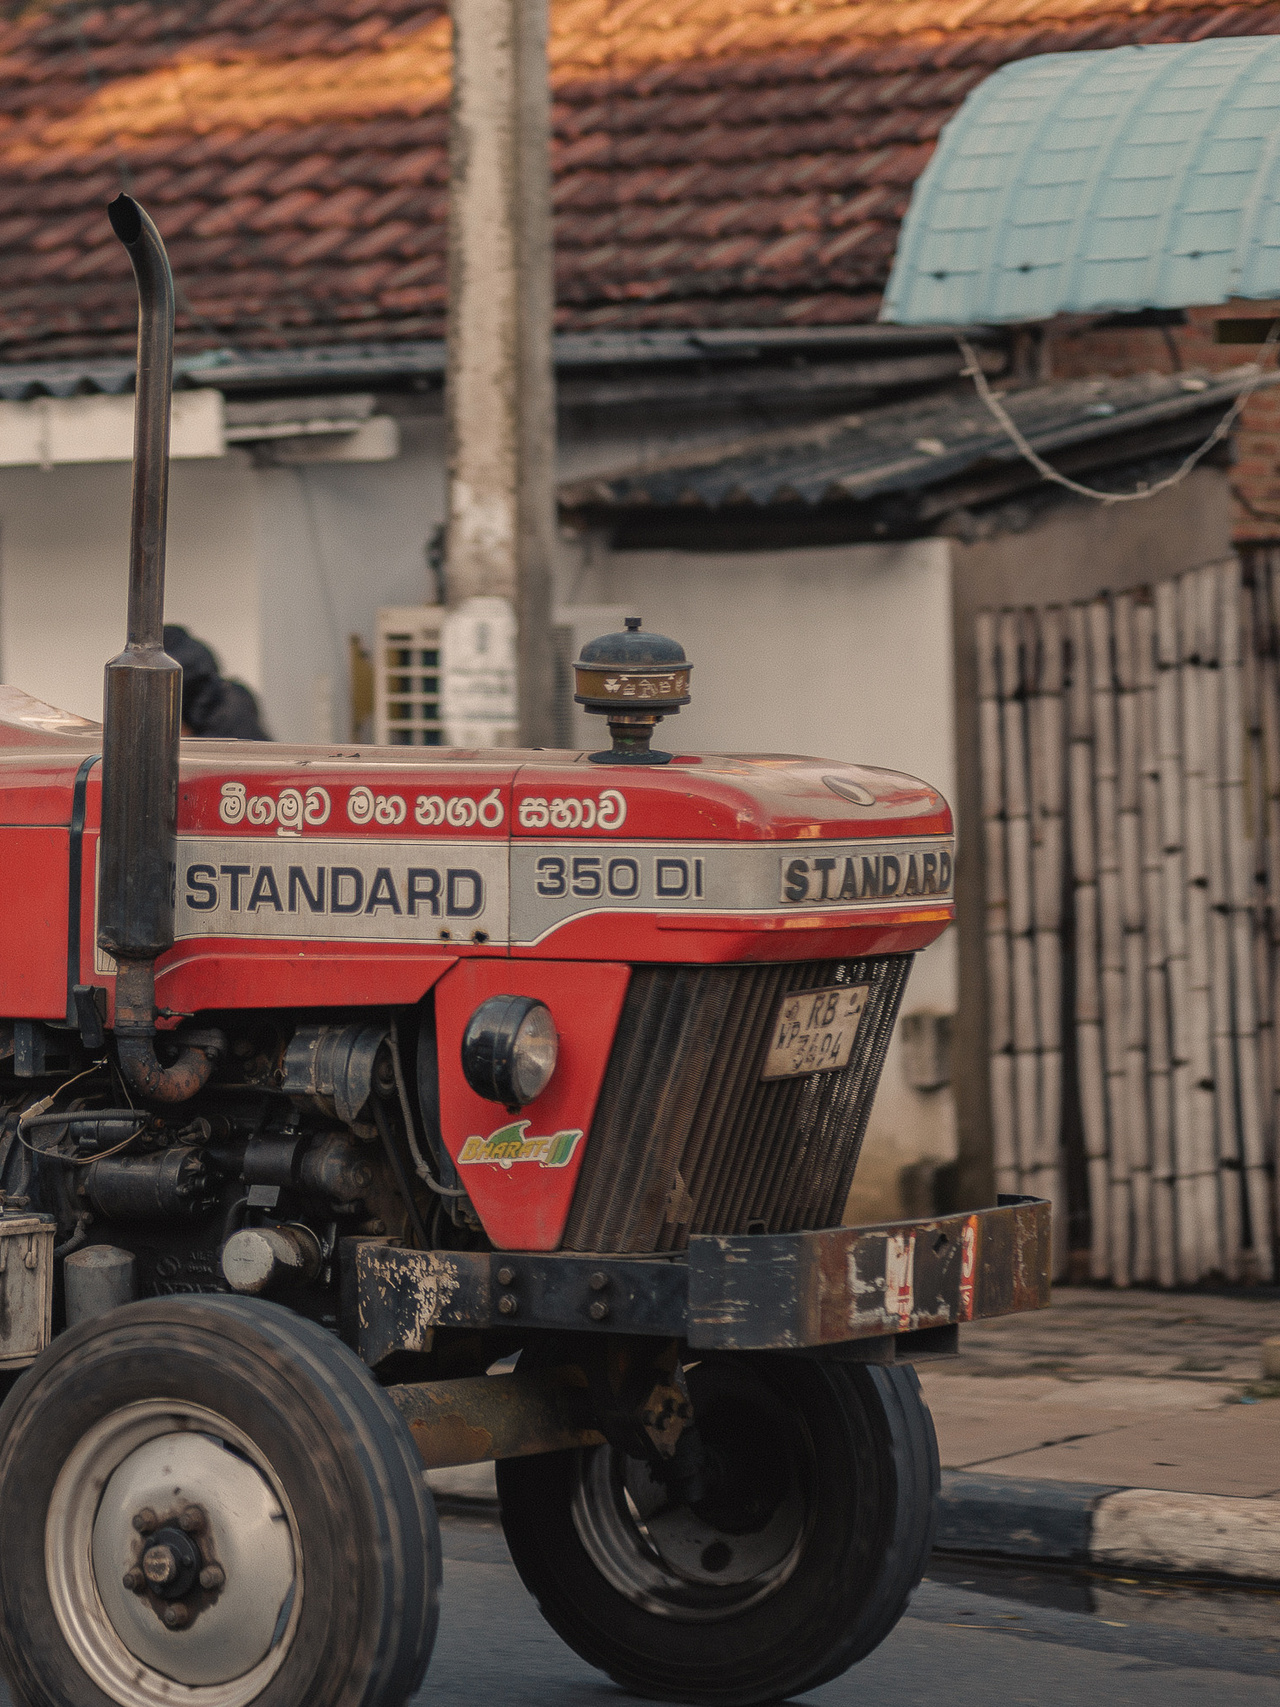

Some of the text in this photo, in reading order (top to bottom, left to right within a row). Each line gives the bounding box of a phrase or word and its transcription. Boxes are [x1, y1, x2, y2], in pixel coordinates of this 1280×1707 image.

[219, 782, 628, 837] මීගමුව මහ නගර සභාව
[186, 863, 486, 919] STANDARD
[535, 855, 706, 900] 350 DI
[782, 850, 953, 903] STANDARD
